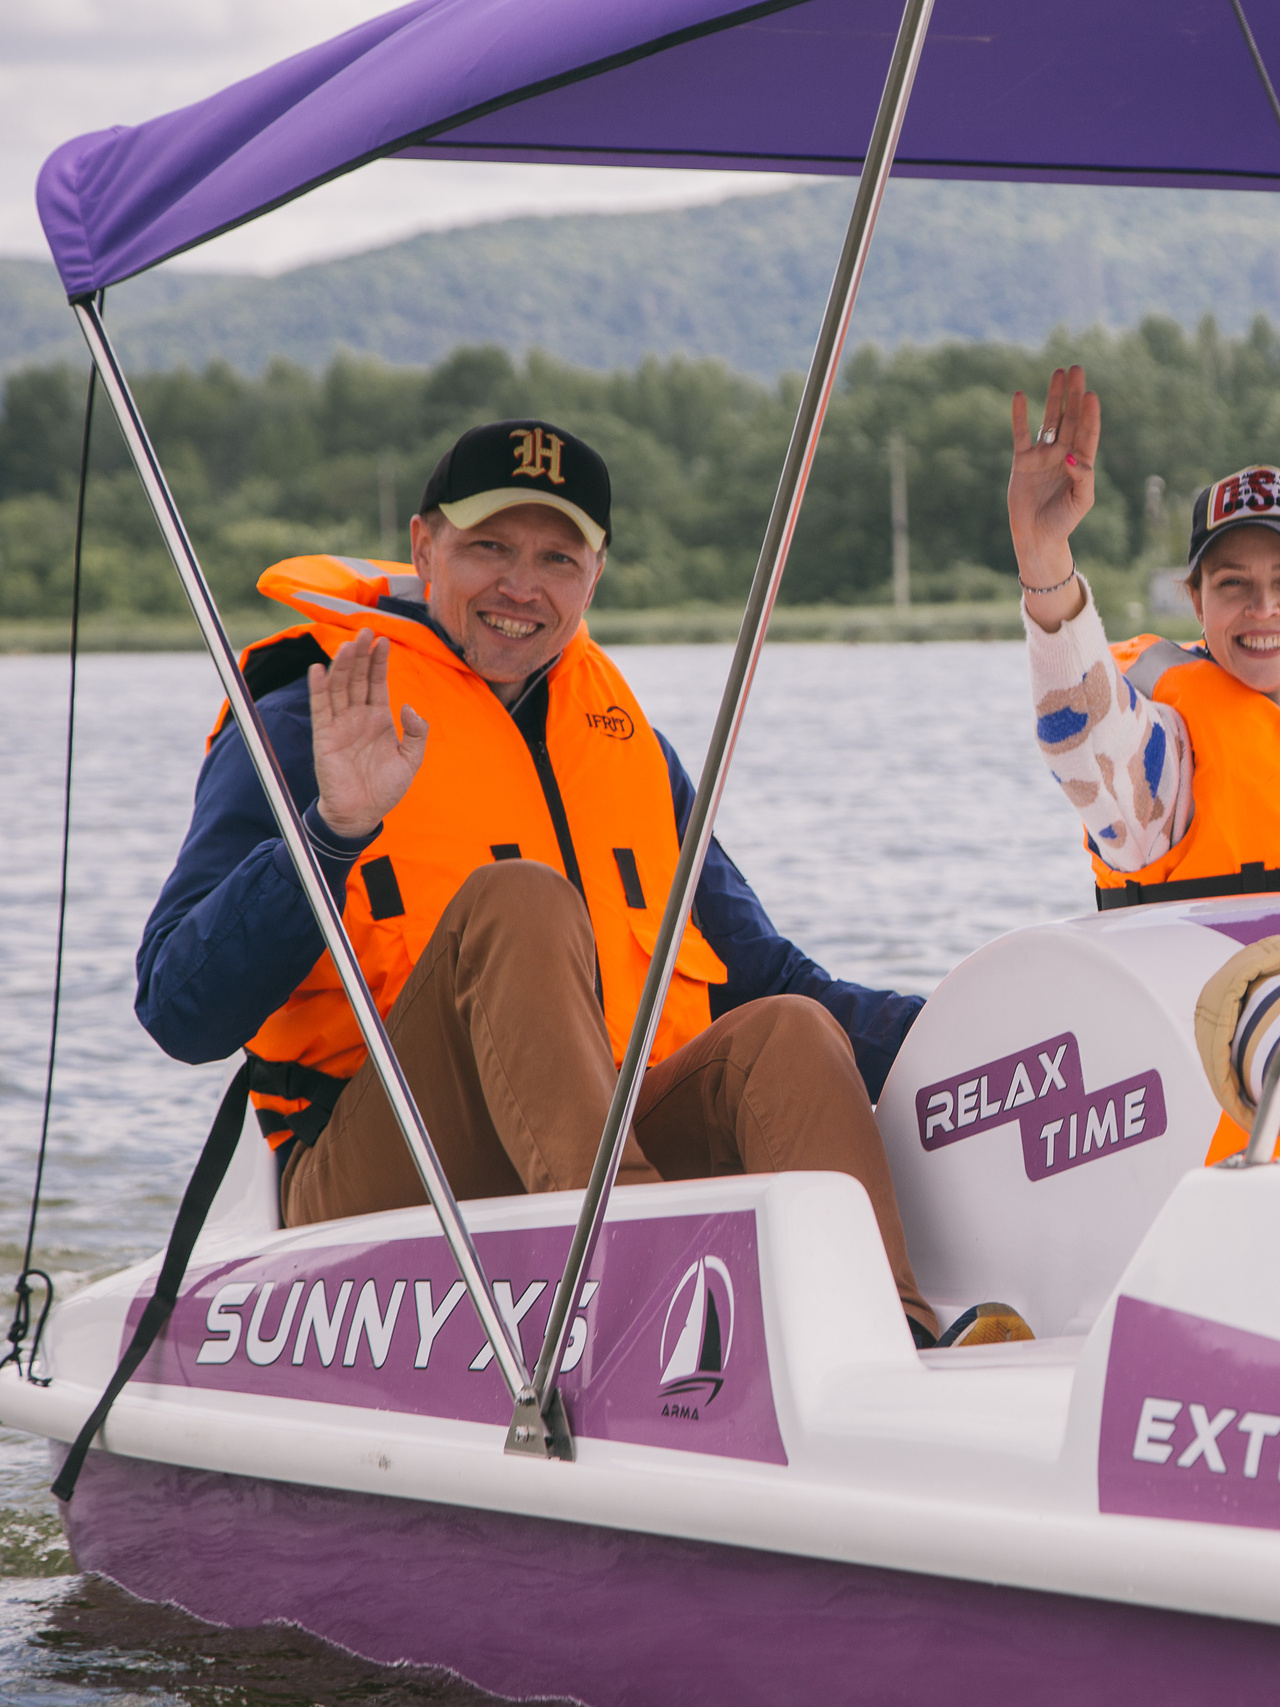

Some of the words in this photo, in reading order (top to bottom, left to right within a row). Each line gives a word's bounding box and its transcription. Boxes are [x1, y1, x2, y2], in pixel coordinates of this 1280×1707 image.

[925, 1043, 1068, 1140] RELAX
[1039, 1085, 1147, 1168] TIME
[195, 1277, 468, 1369] SUNNY
[661, 1403, 699, 1421] ARMA
